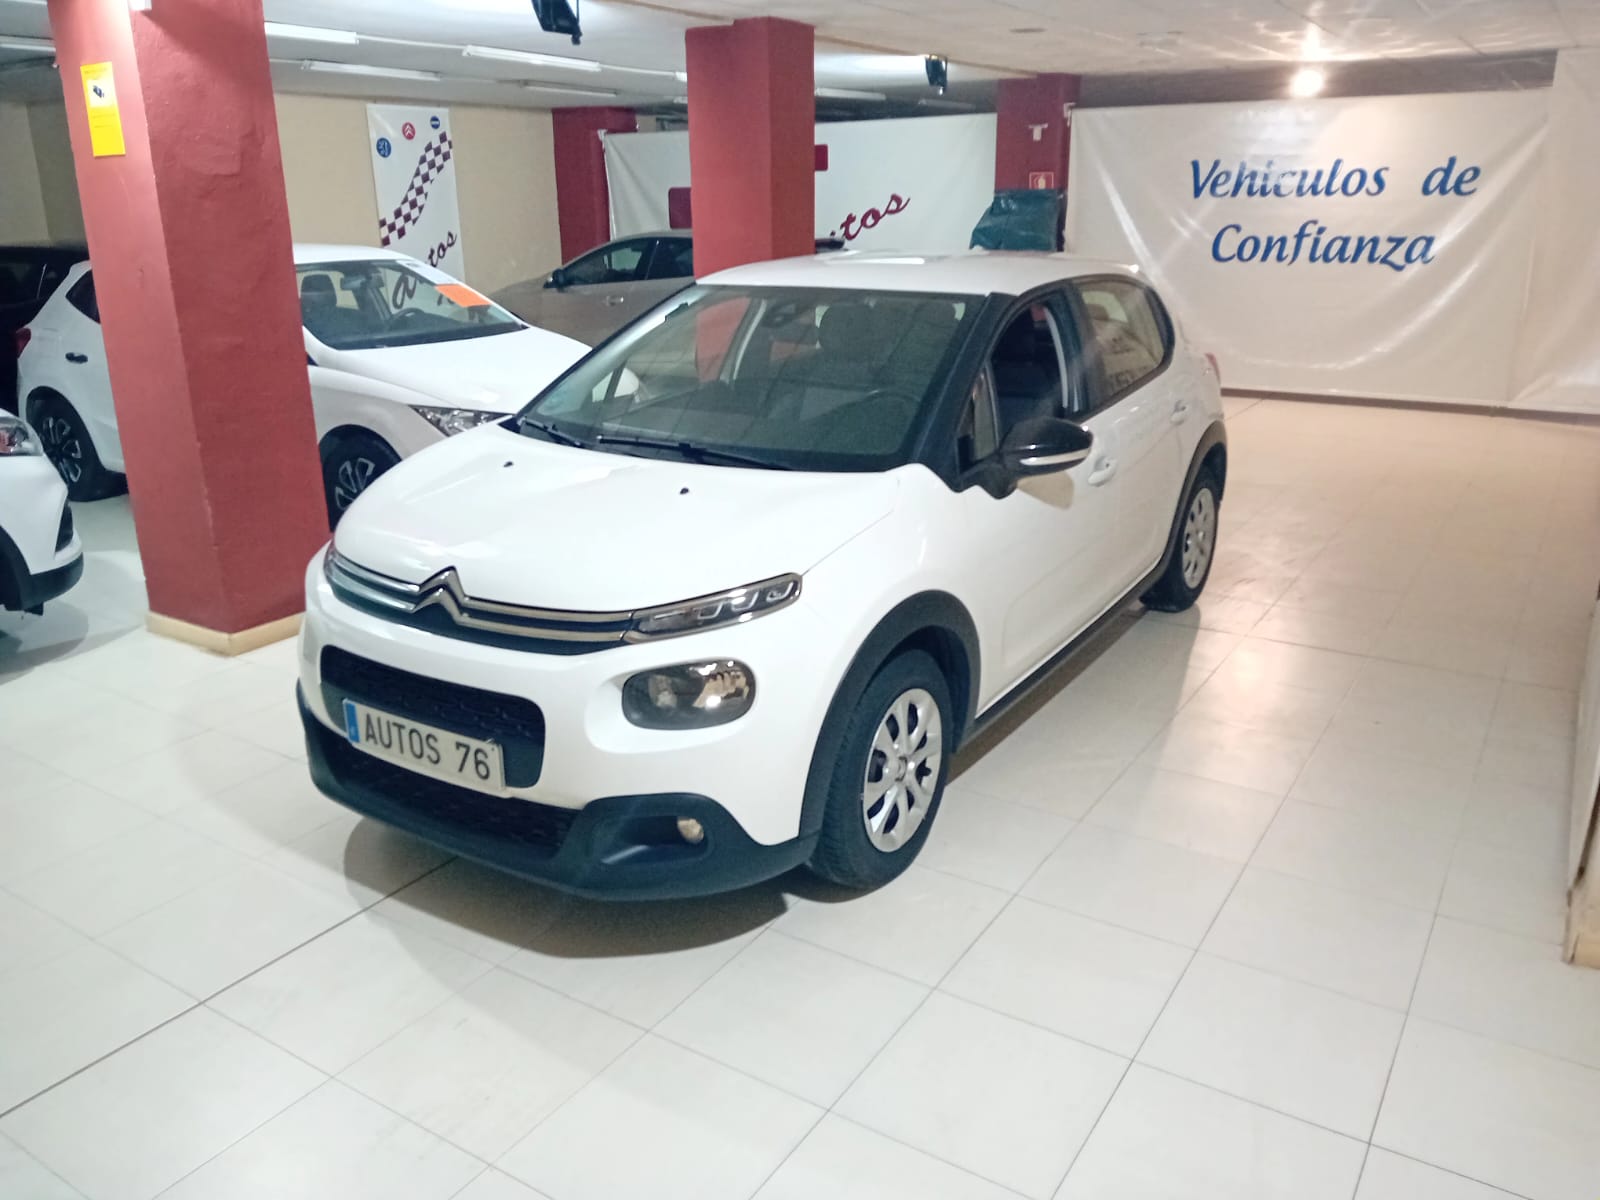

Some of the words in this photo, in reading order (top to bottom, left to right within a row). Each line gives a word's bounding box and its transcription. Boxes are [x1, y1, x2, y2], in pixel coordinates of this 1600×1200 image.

[1191, 158, 1390, 199] Vehiculos
[1421, 155, 1481, 197] de
[1211, 219, 1436, 272] Confianza
[365, 713, 441, 765] AUTOS
[455, 741, 491, 780] 76
